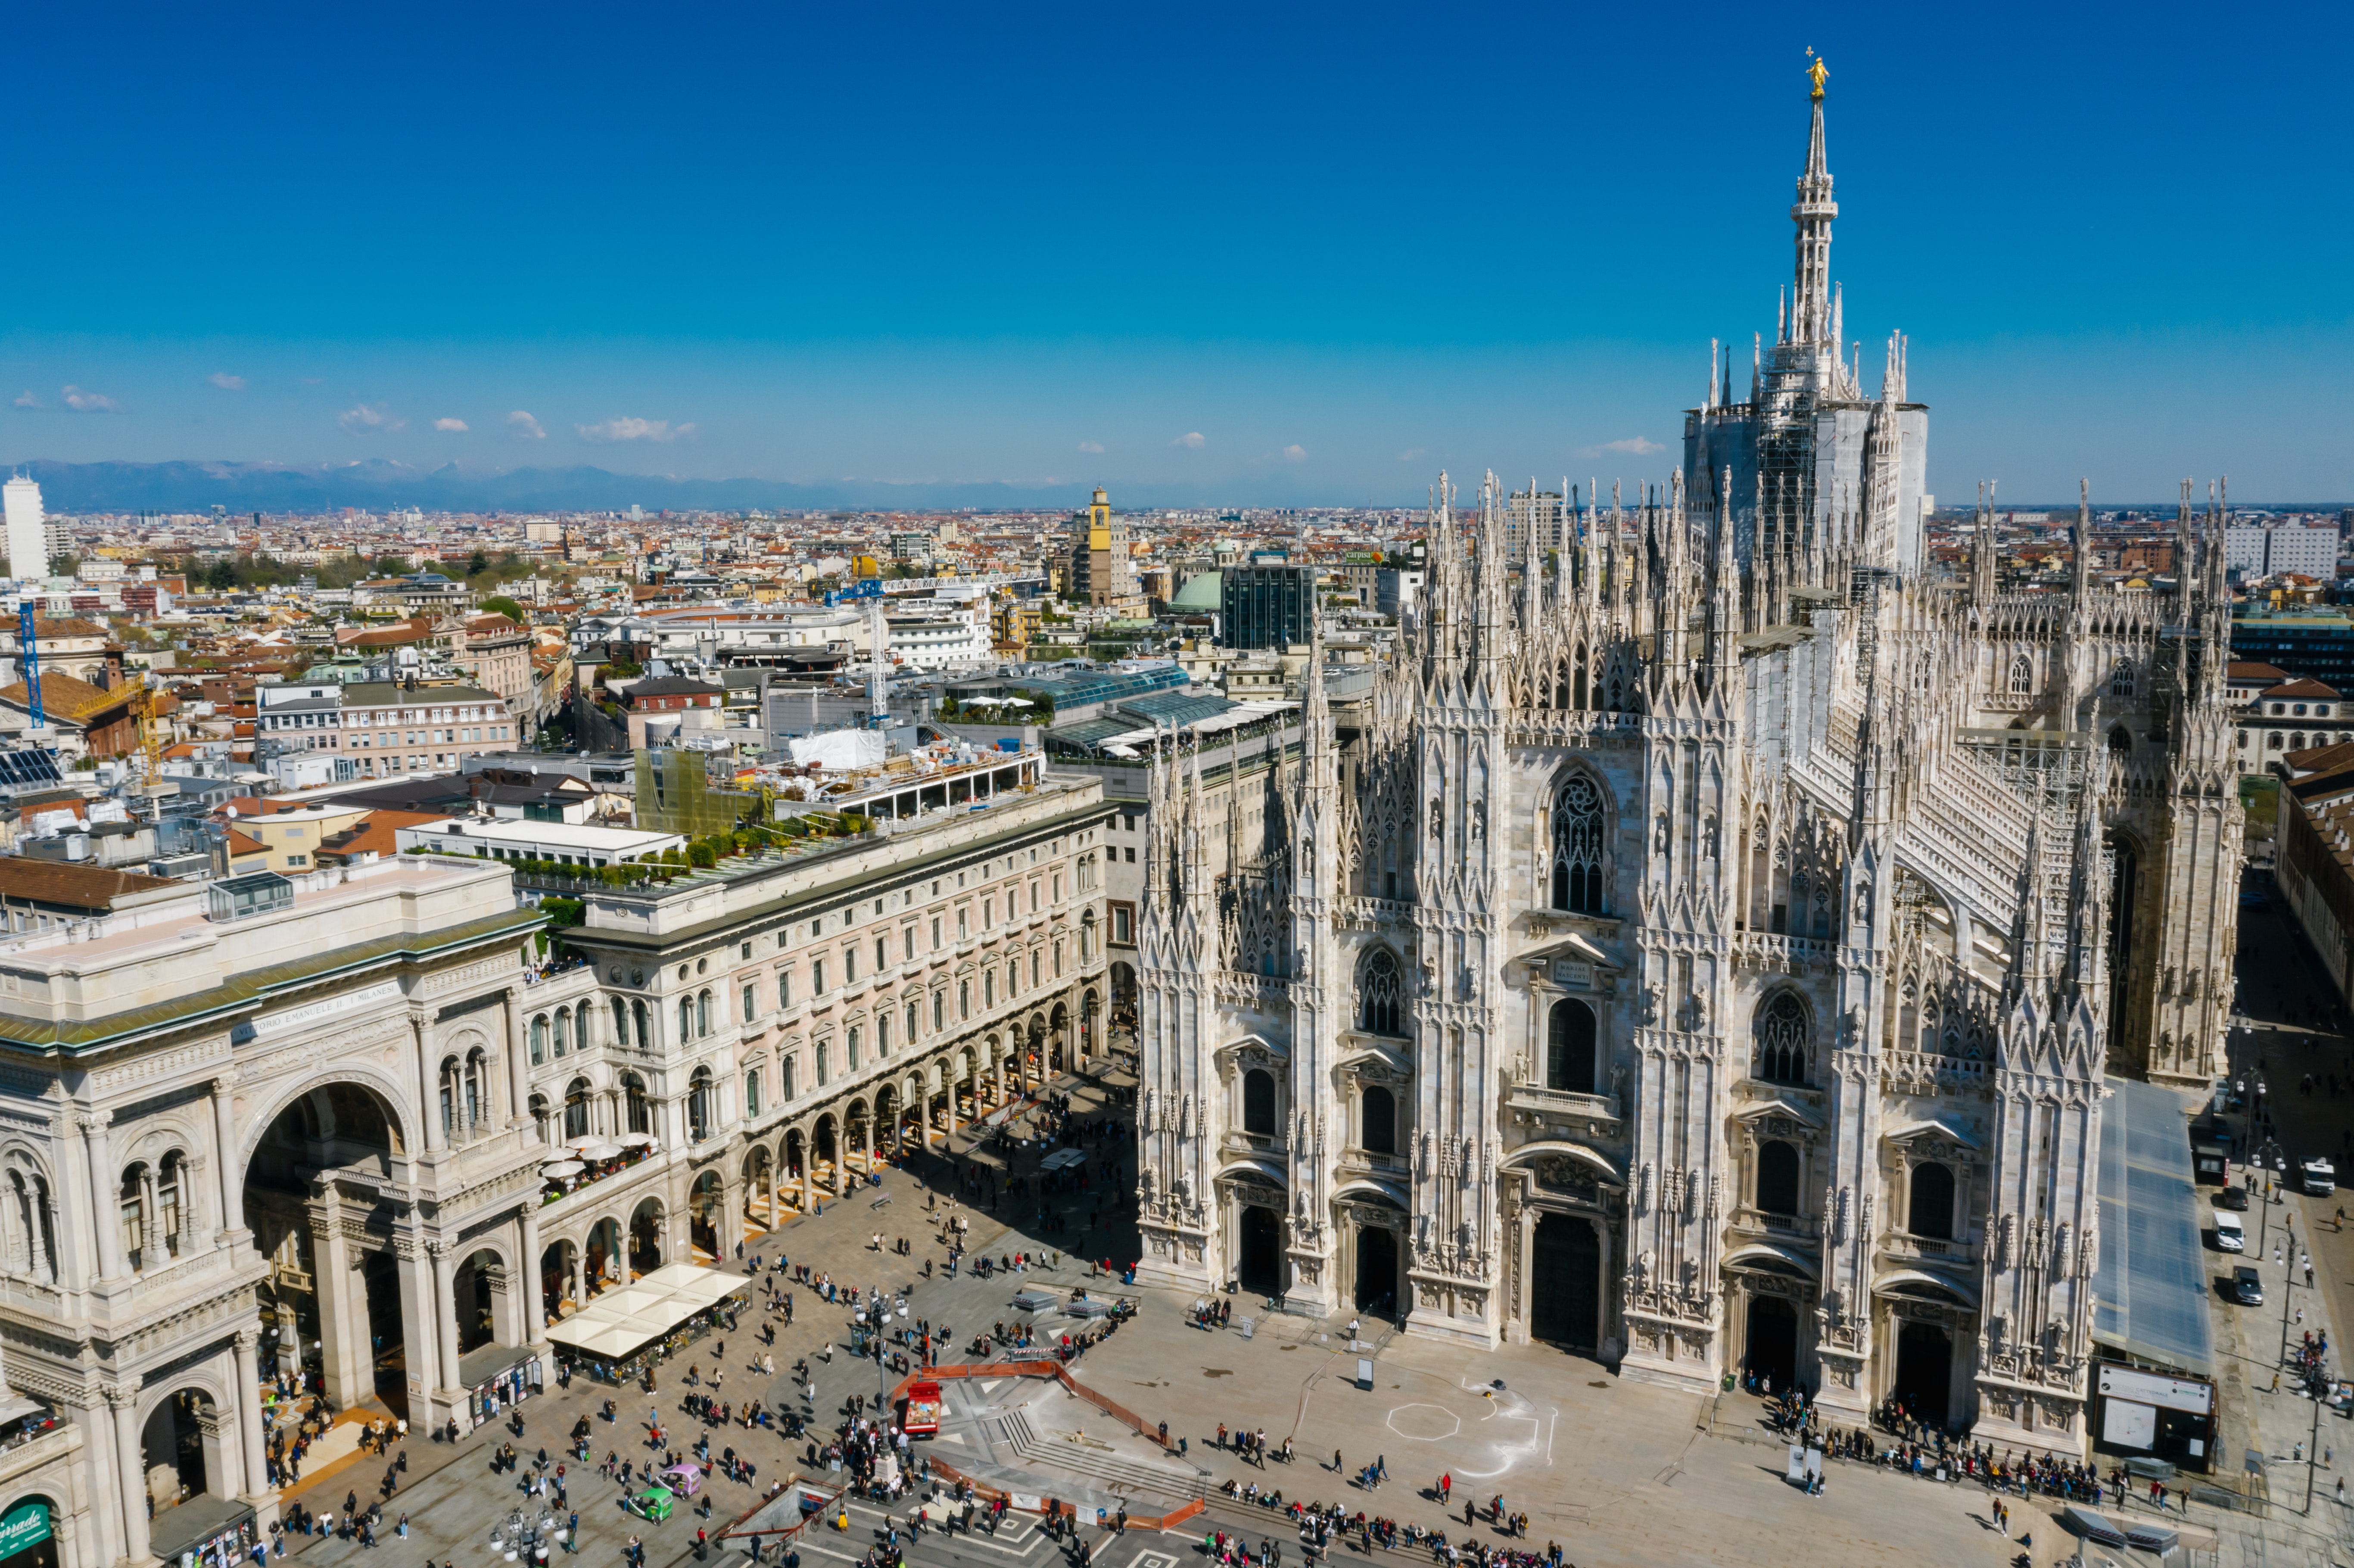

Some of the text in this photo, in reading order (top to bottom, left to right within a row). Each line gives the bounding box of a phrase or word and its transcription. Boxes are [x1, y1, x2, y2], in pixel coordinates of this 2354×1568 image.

[1346, 551, 1370, 560] carpisa
[239, 1018, 280, 1035] VITTORIO
[286, 1003, 332, 1023] EMANUELE
[358, 985, 394, 1002] MILANESI
